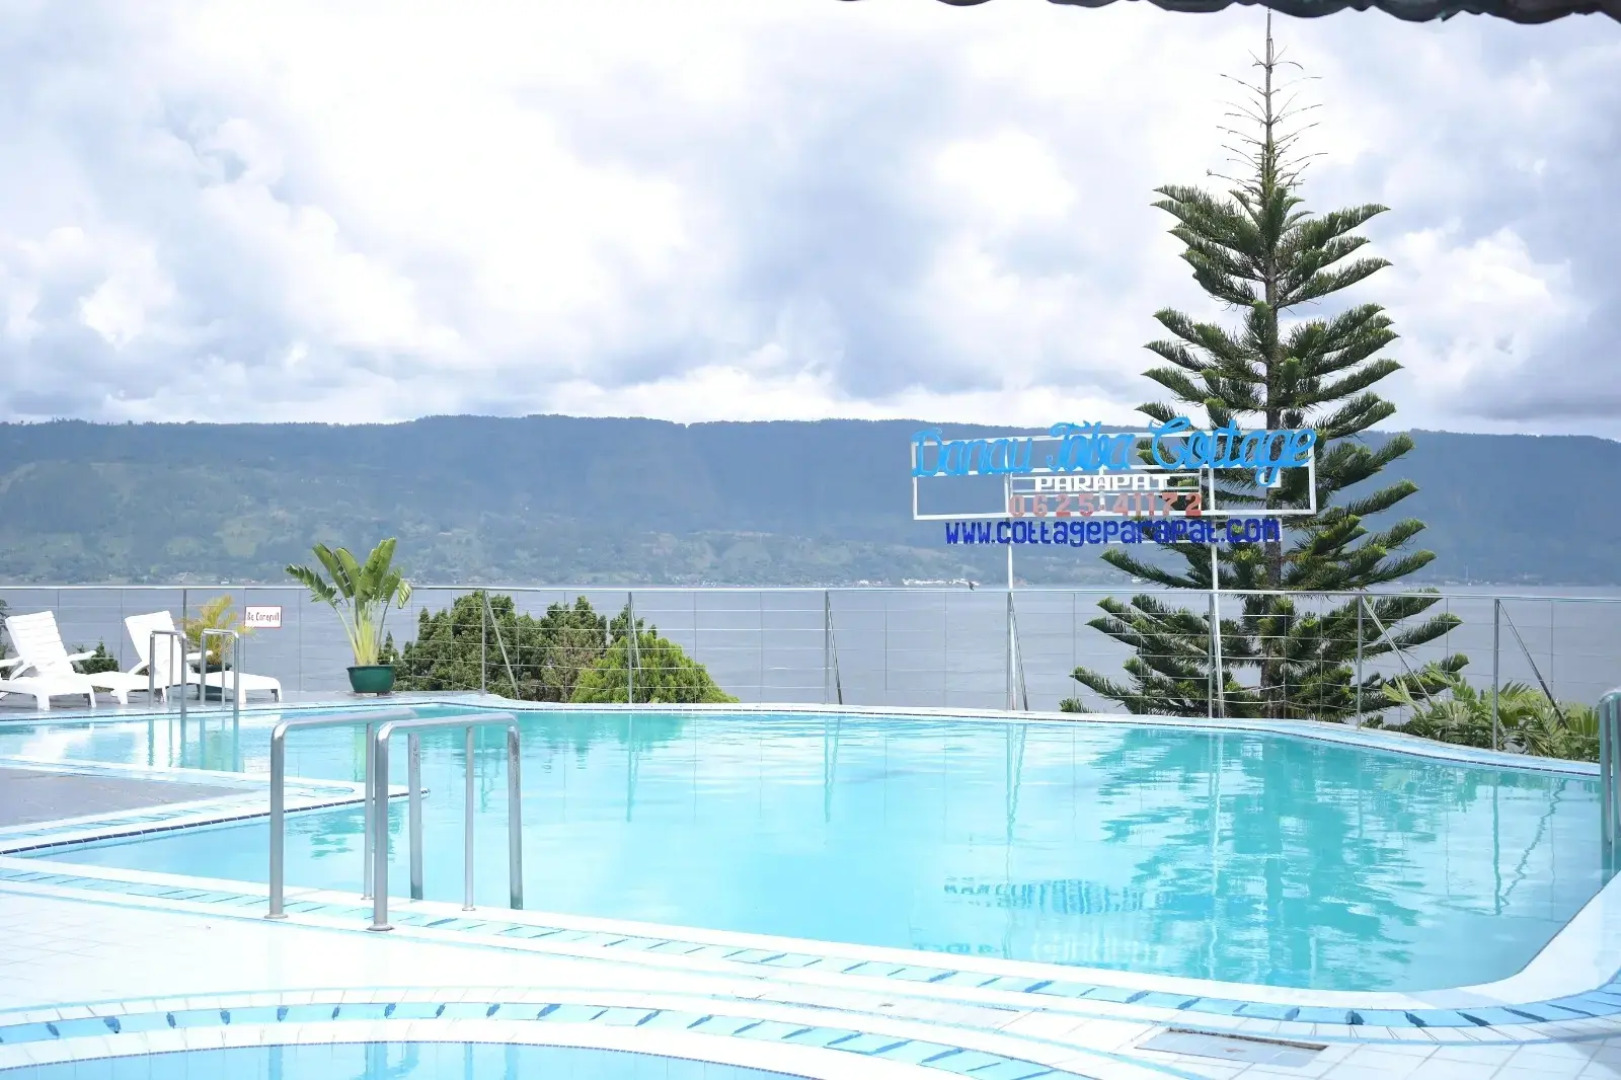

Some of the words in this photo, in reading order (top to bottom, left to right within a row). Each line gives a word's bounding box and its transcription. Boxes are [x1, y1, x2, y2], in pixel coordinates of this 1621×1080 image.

[912, 427, 1033, 477] Danau
[1046, 420, 1135, 471] Toba
[1150, 416, 1317, 487] Cottage
[1035, 475, 1171, 492] PARAPAT
